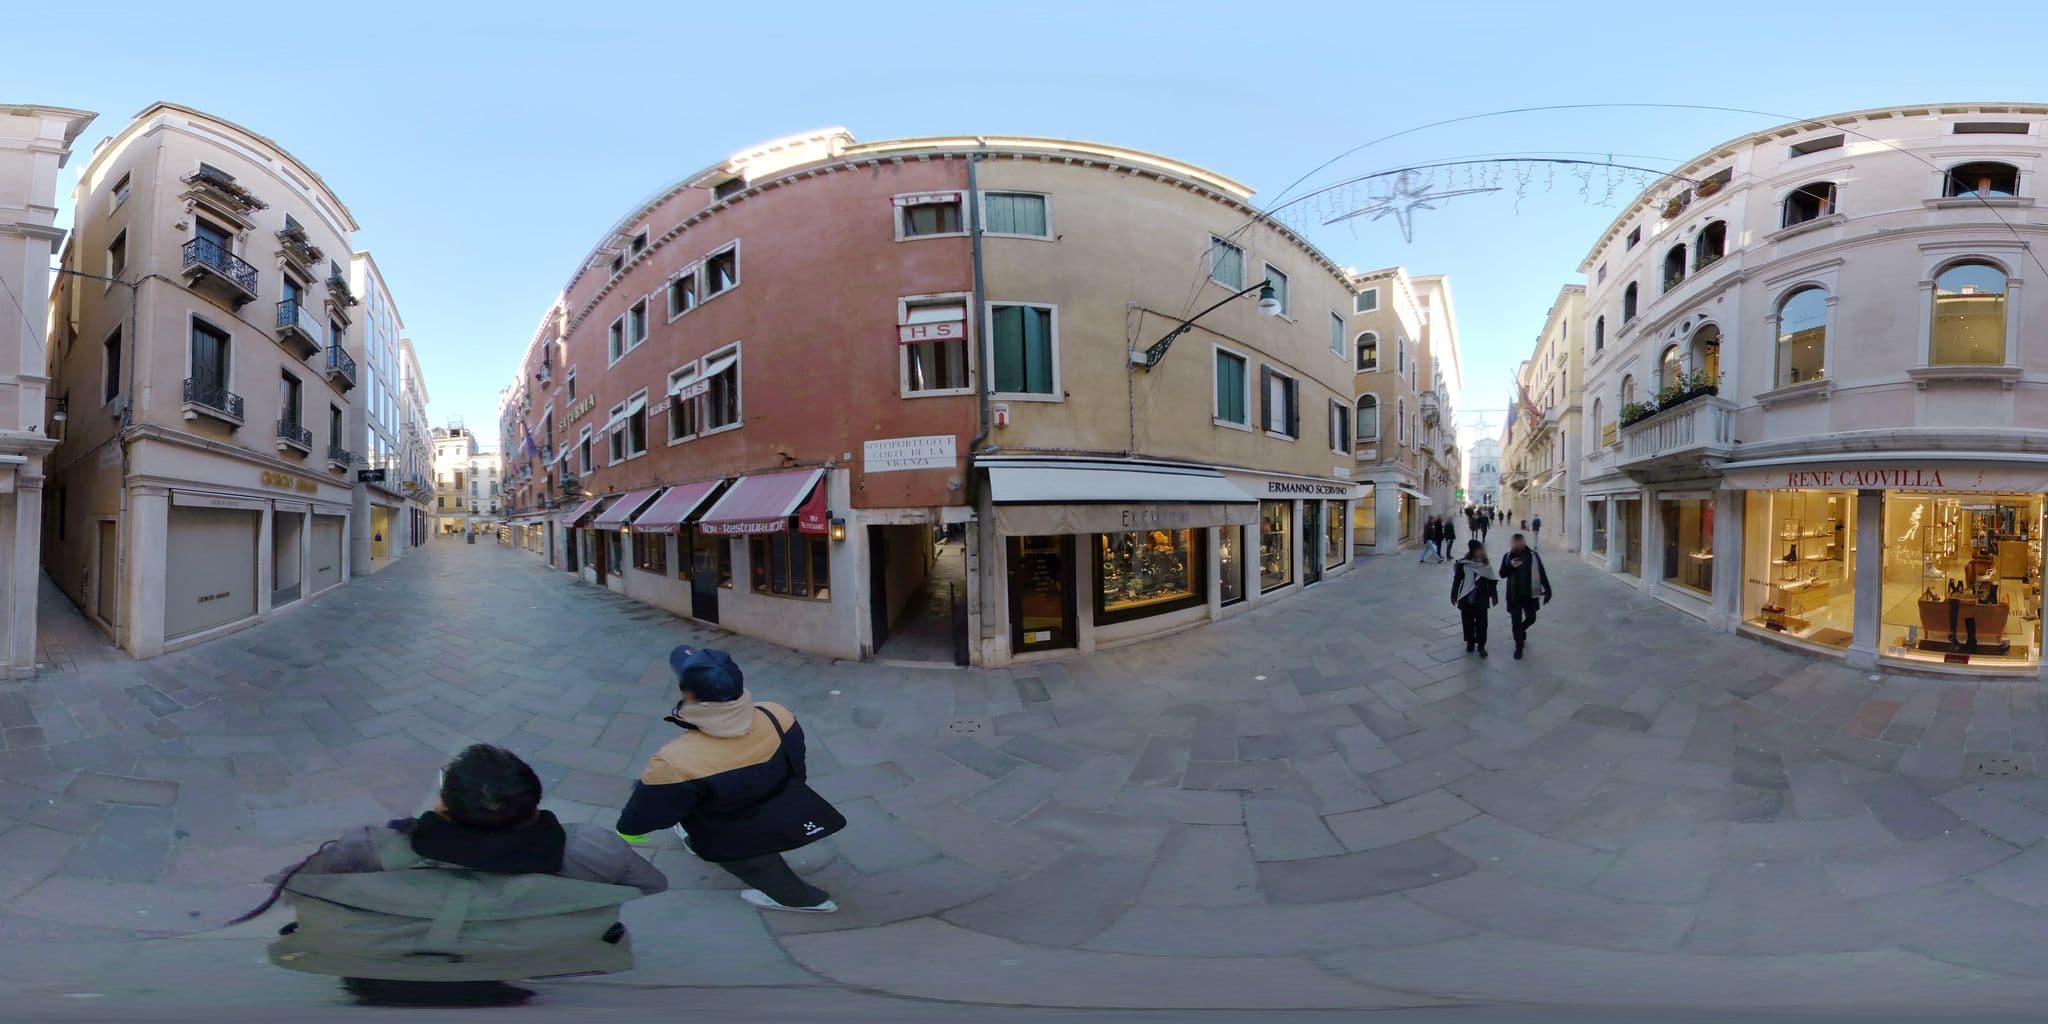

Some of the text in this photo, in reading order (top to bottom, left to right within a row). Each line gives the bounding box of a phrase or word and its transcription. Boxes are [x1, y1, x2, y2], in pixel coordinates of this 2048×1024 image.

[1788, 469, 1945, 488] RENE CAOVILLA
[1268, 481, 1347, 496] ERMANNO SCERVINO
